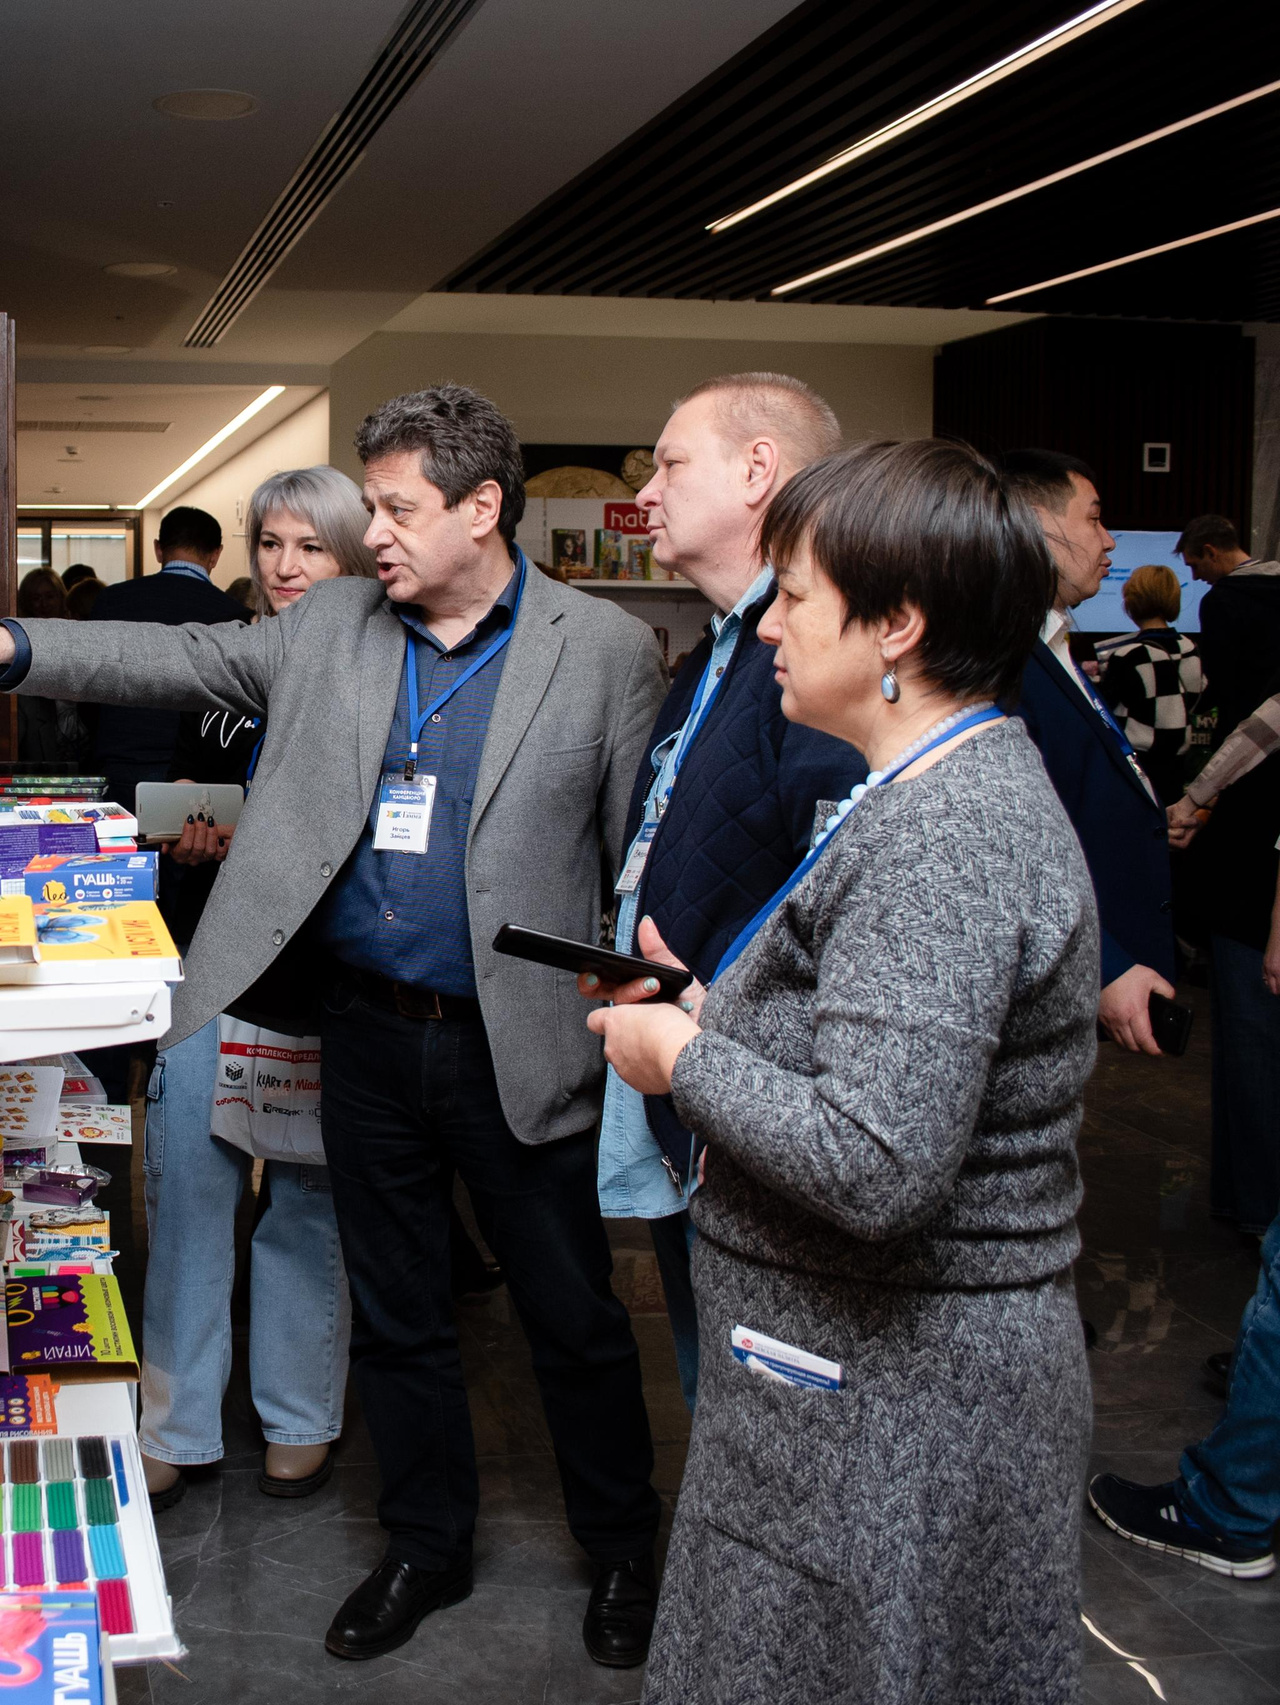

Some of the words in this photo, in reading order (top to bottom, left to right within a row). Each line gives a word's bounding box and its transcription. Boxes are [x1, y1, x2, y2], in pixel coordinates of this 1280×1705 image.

[74, 873, 115, 886] ГУАШЬ
[43, 1344, 91, 1360] ИГРАЙ
[9, 1429, 53, 1438] РИСОВАНИЯ
[52, 1631, 91, 1705] ГУАШЬ
